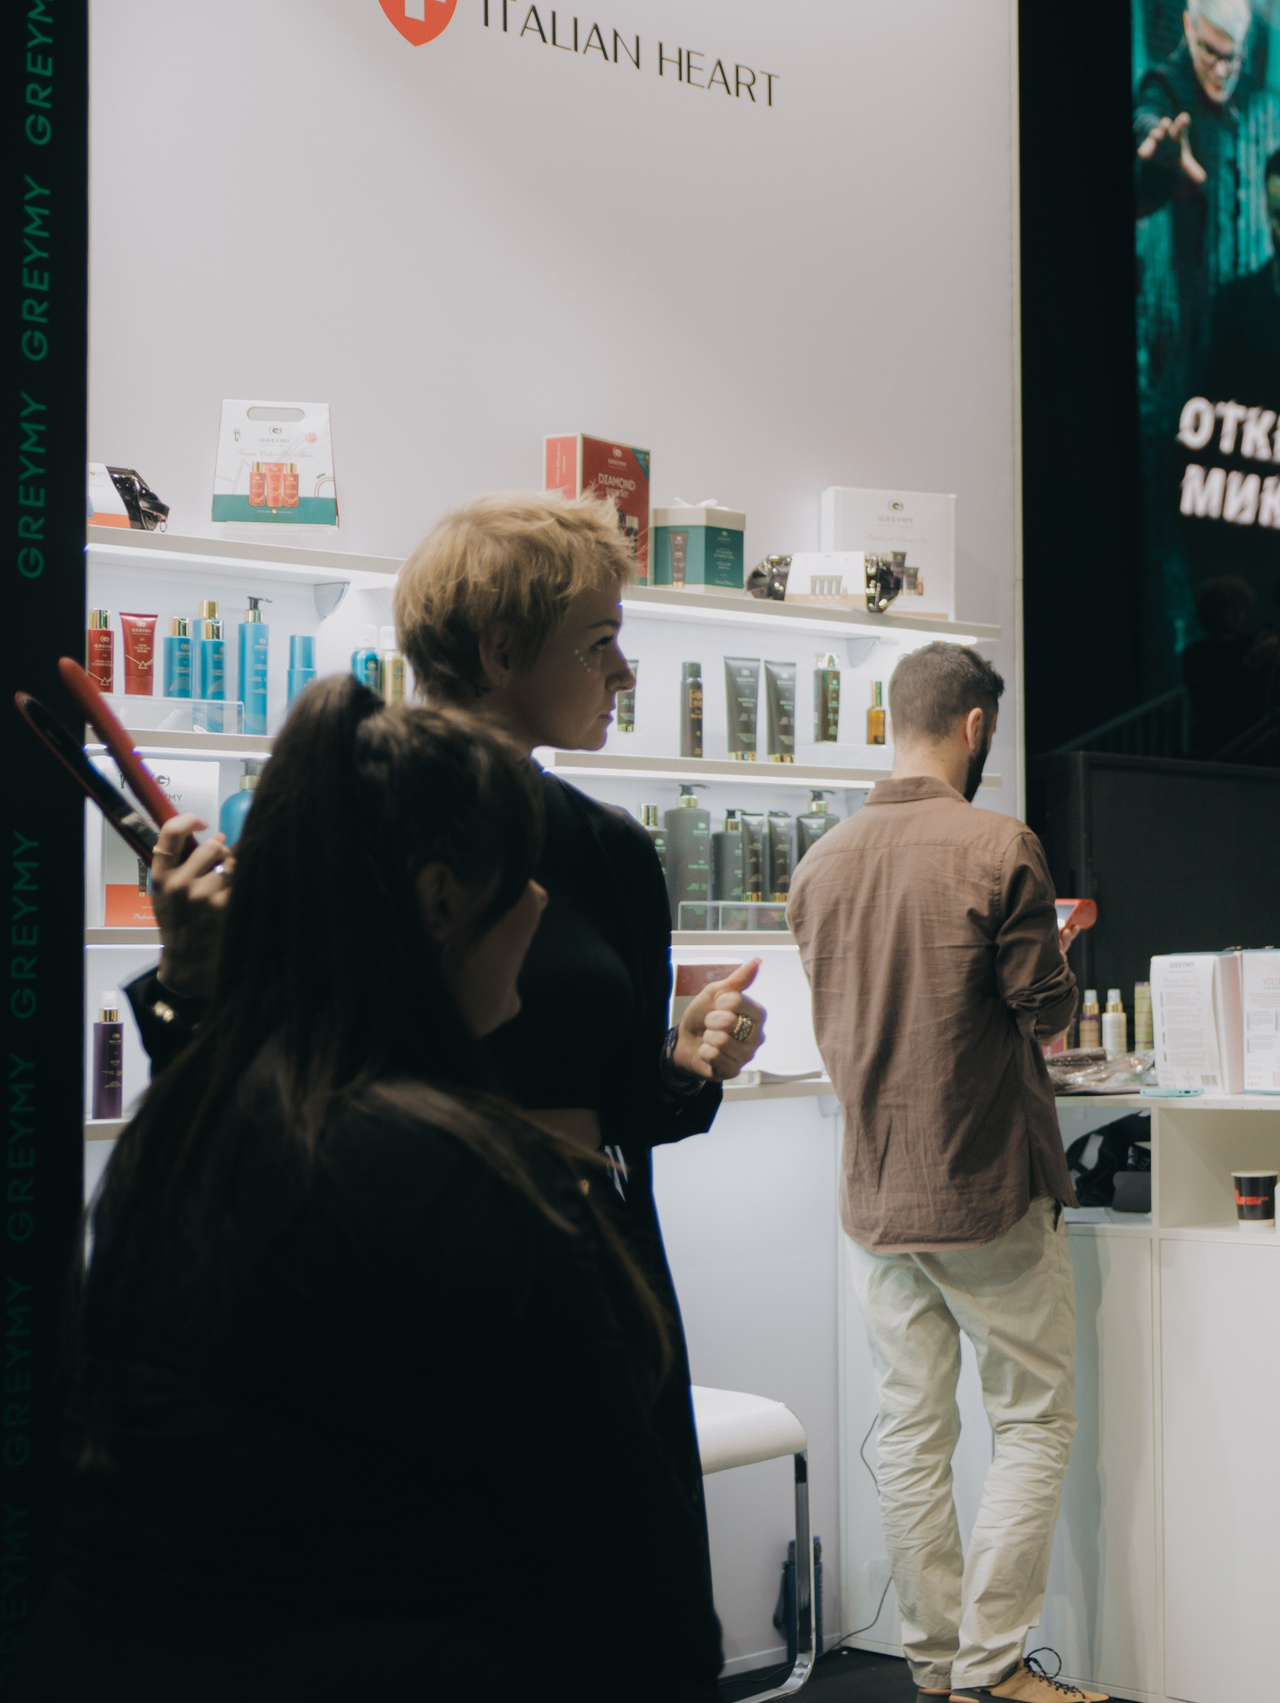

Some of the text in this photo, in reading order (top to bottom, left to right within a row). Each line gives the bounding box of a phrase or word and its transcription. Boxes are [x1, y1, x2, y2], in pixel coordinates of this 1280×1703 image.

[483, 0, 780, 107] ITALIAN HEART
[22, 174, 52, 363] GREYMY
[17, 392, 48, 580] GREYMY
[597, 472, 637, 492] DIAMOND
[9, 830, 43, 1020] GREYMY
[6, 1053, 36, 1243] GREYMY
[3, 1278, 34, 1468] GREYMY
